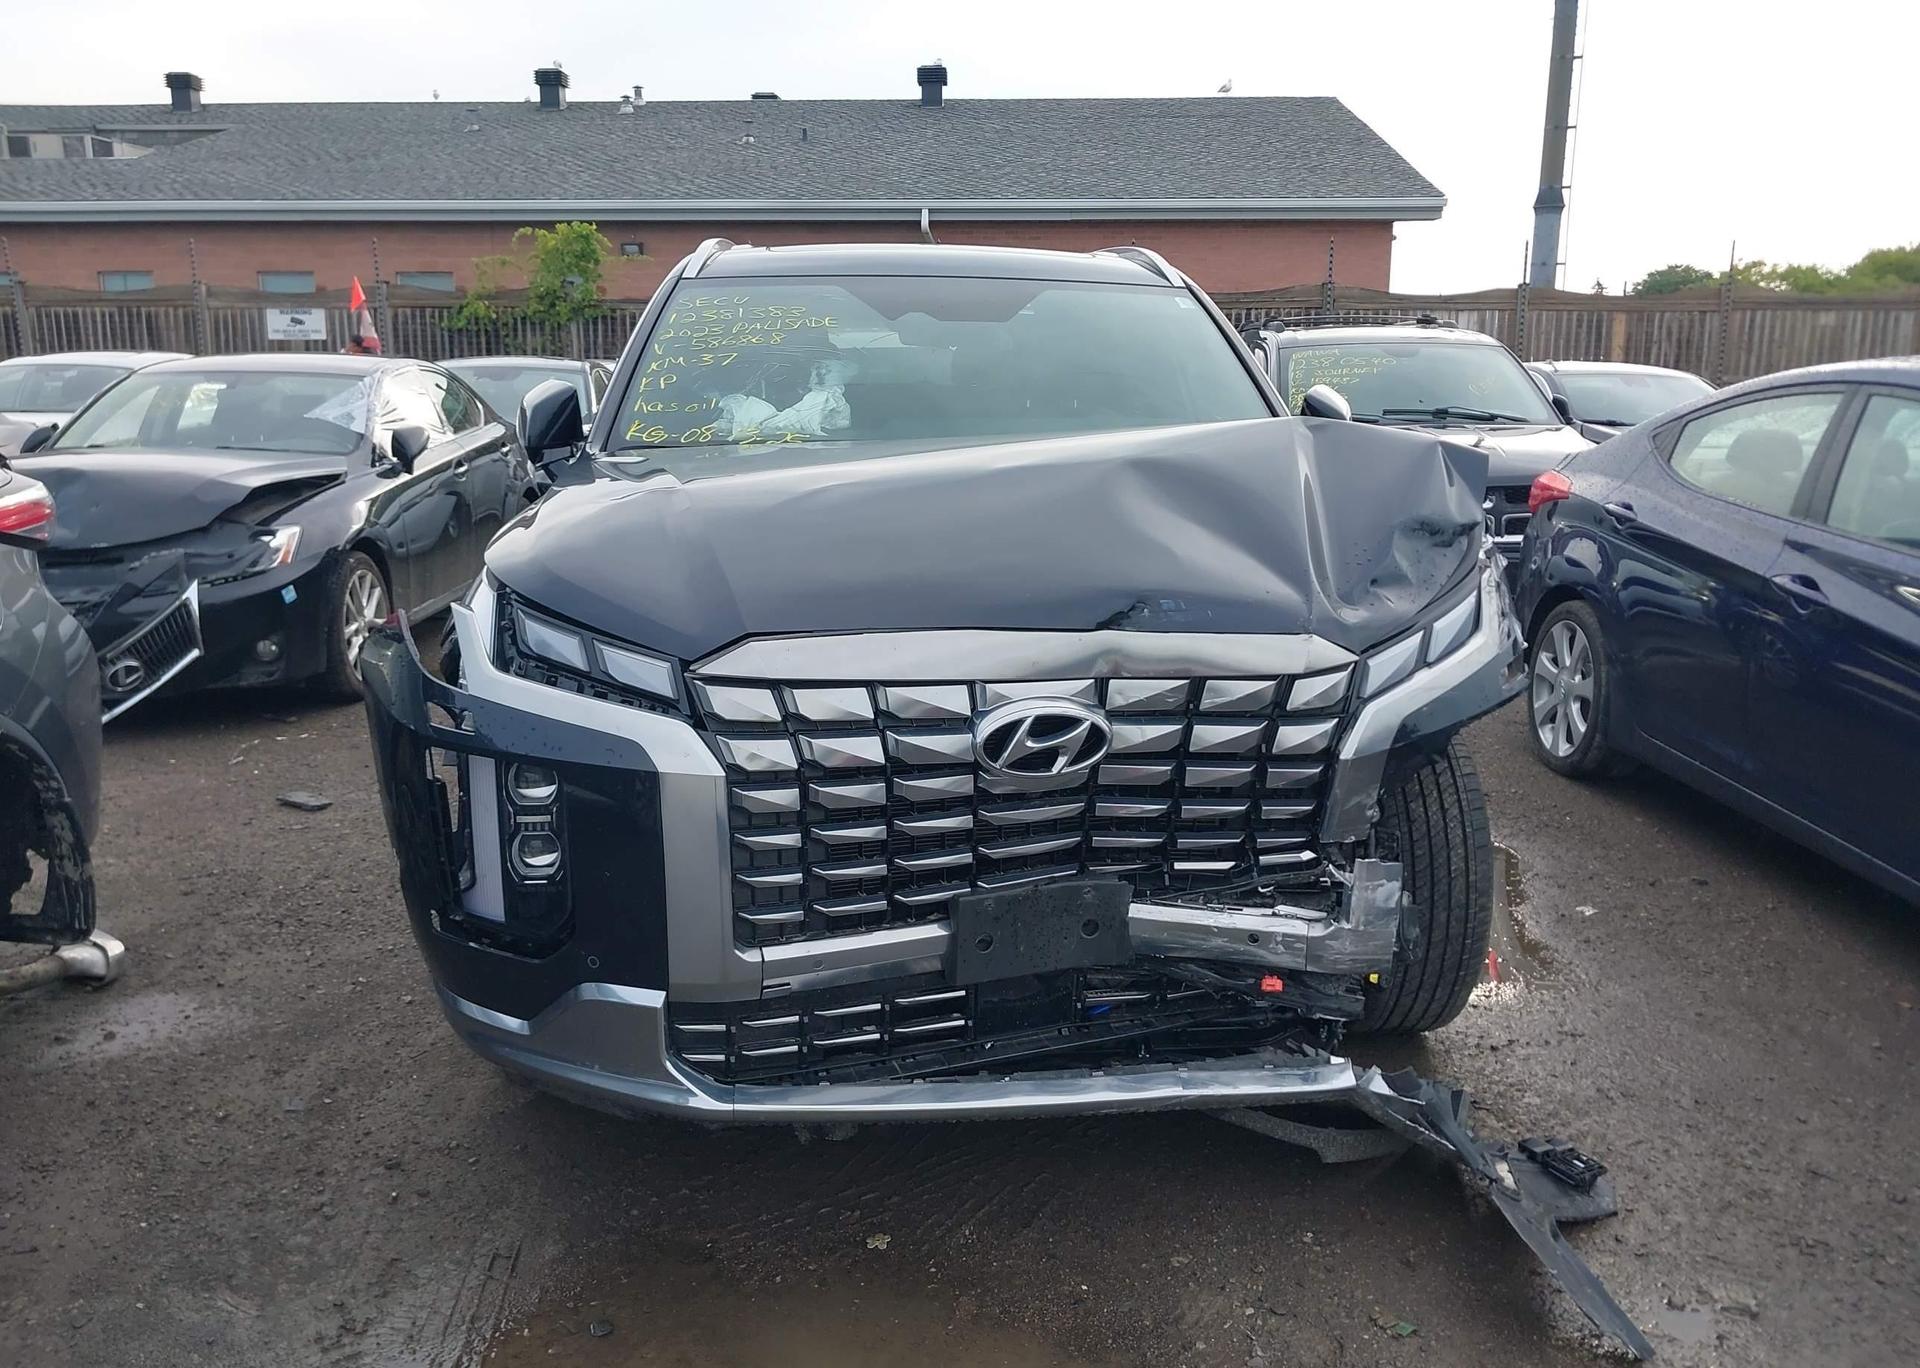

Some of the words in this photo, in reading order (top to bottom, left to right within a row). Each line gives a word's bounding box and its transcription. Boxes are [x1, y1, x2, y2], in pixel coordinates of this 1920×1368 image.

[668, 305, 806, 325] 12381383
[660, 324, 725, 341] 2023
[732, 316, 840, 334] PALISADE
[638, 374, 678, 393] KP
[633, 397, 677, 414] has
[684, 395, 718, 413] oil
